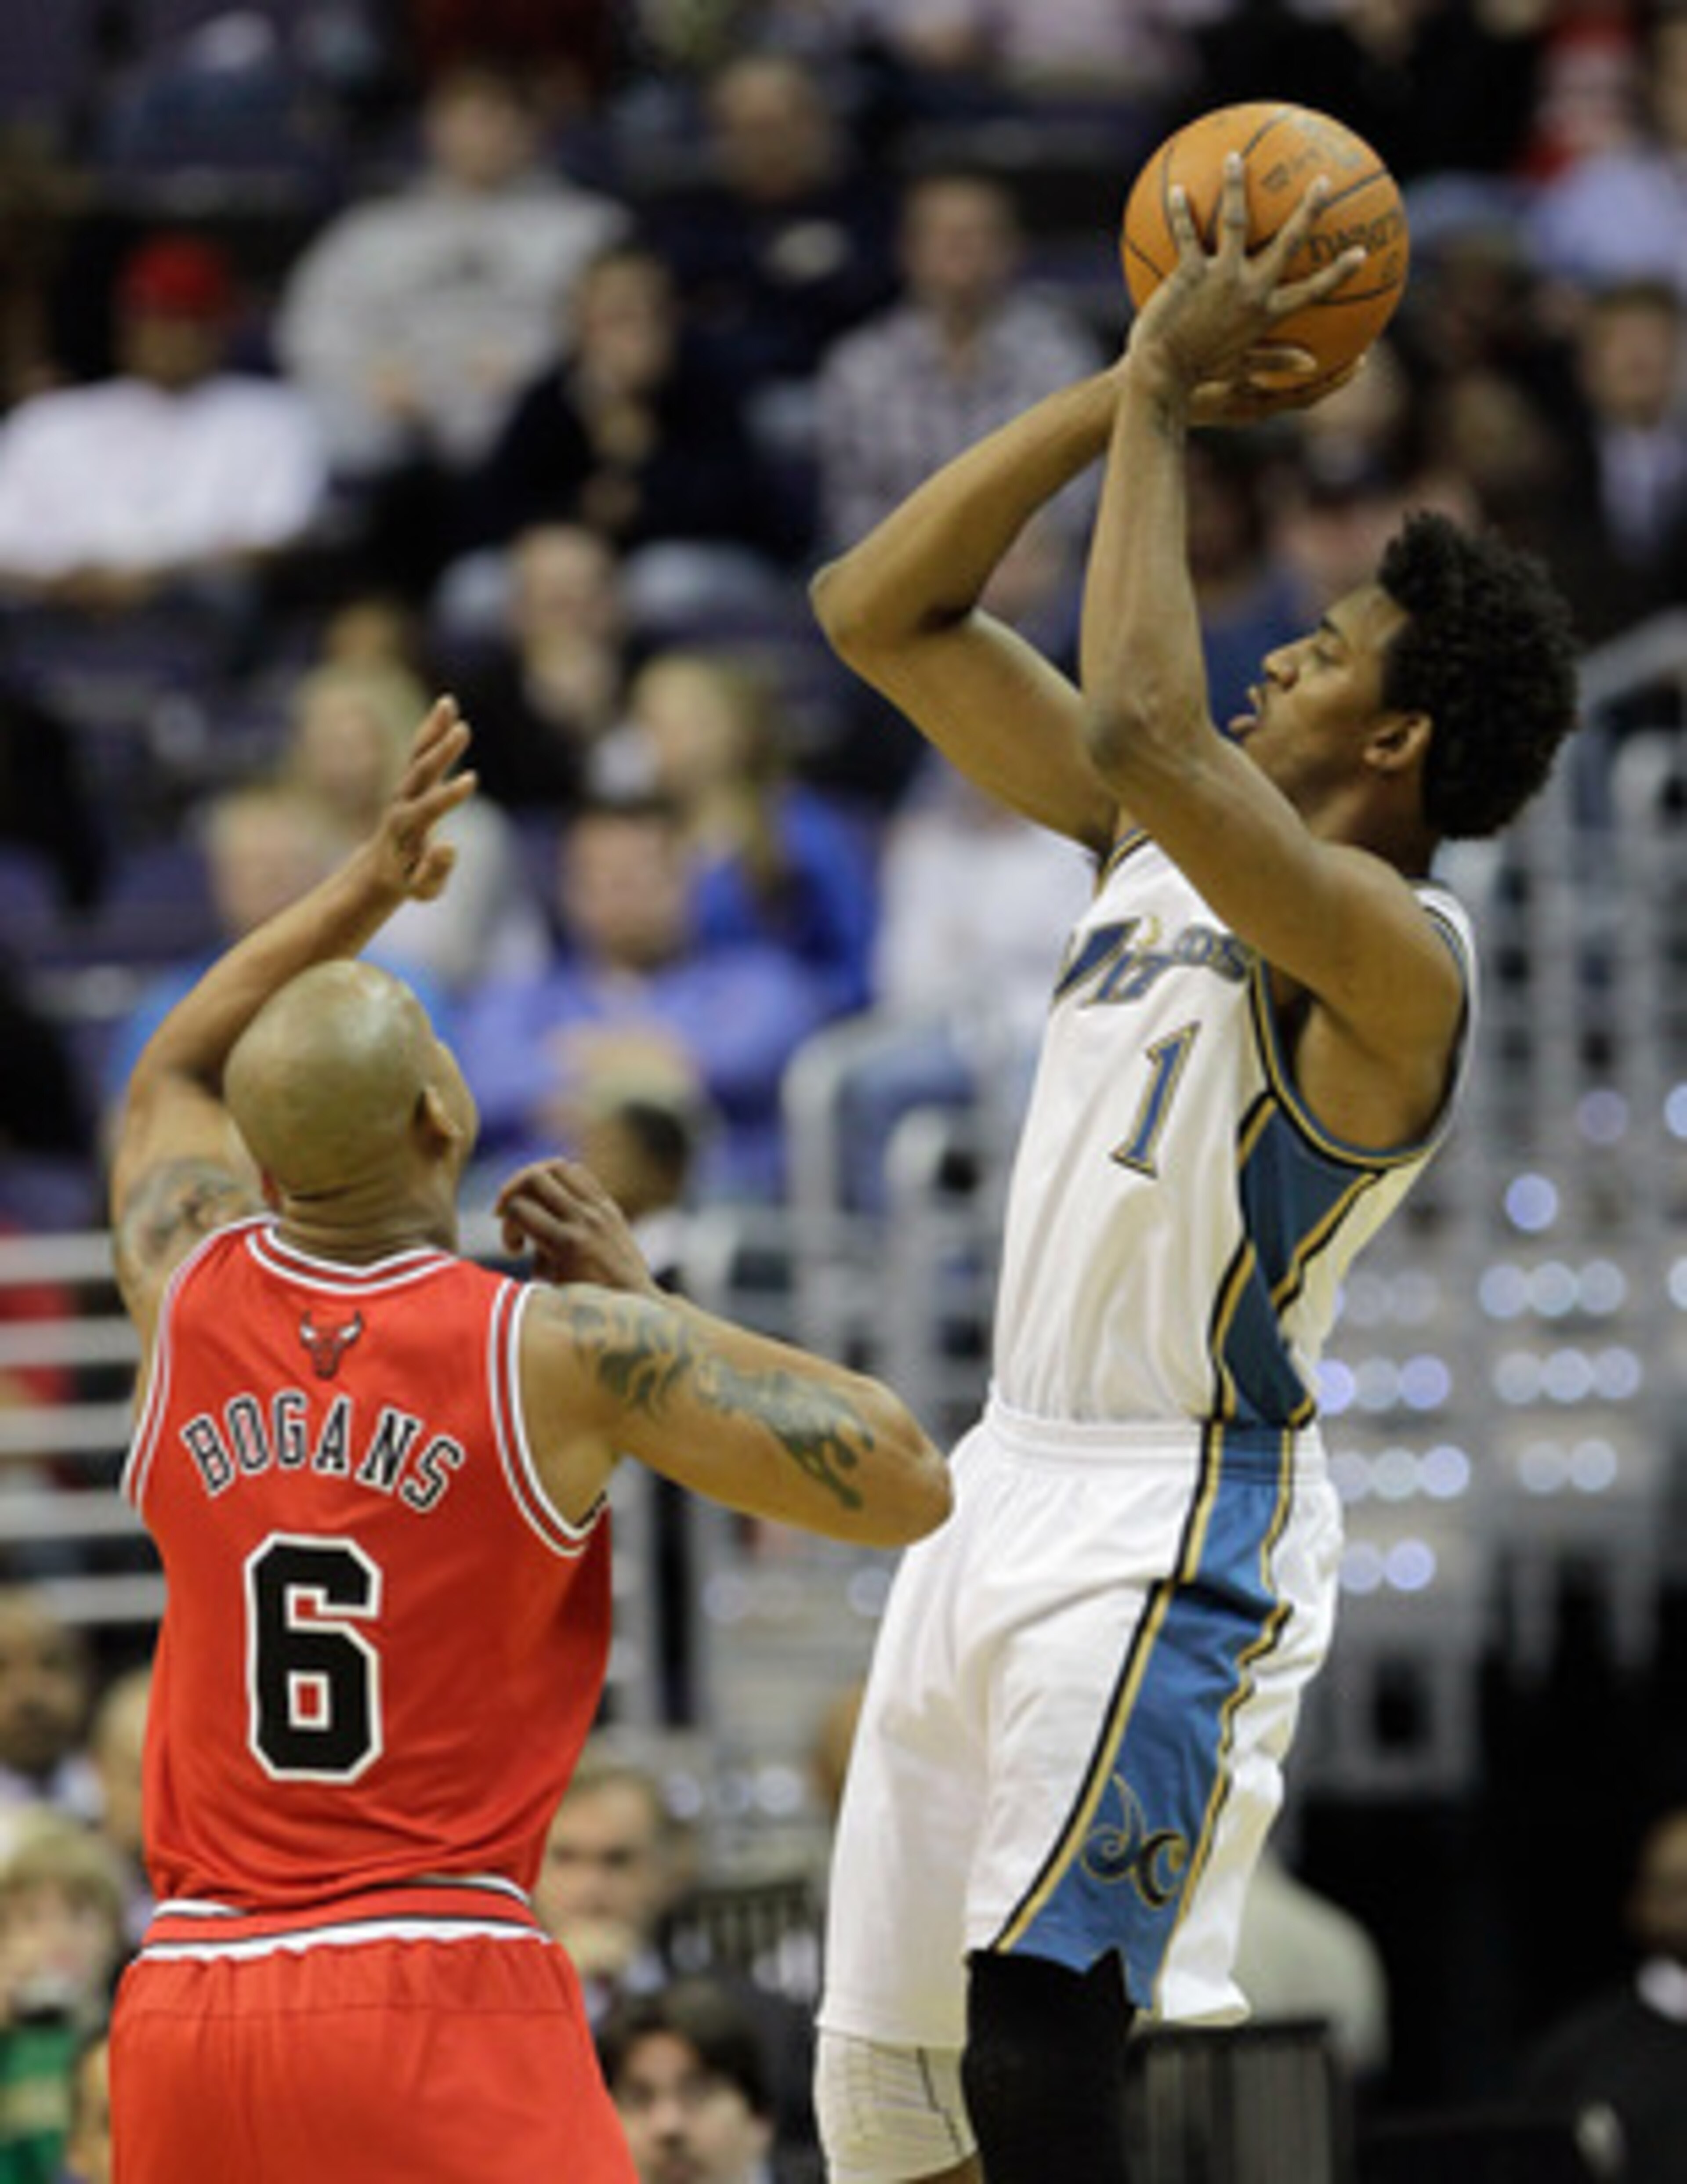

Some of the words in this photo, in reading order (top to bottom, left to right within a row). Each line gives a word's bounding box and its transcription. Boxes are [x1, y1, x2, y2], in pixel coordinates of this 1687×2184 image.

[1109, 1019, 1202, 1180] 1
[178, 1387, 465, 1512] BOGANS
[243, 1530, 384, 1784] 6
